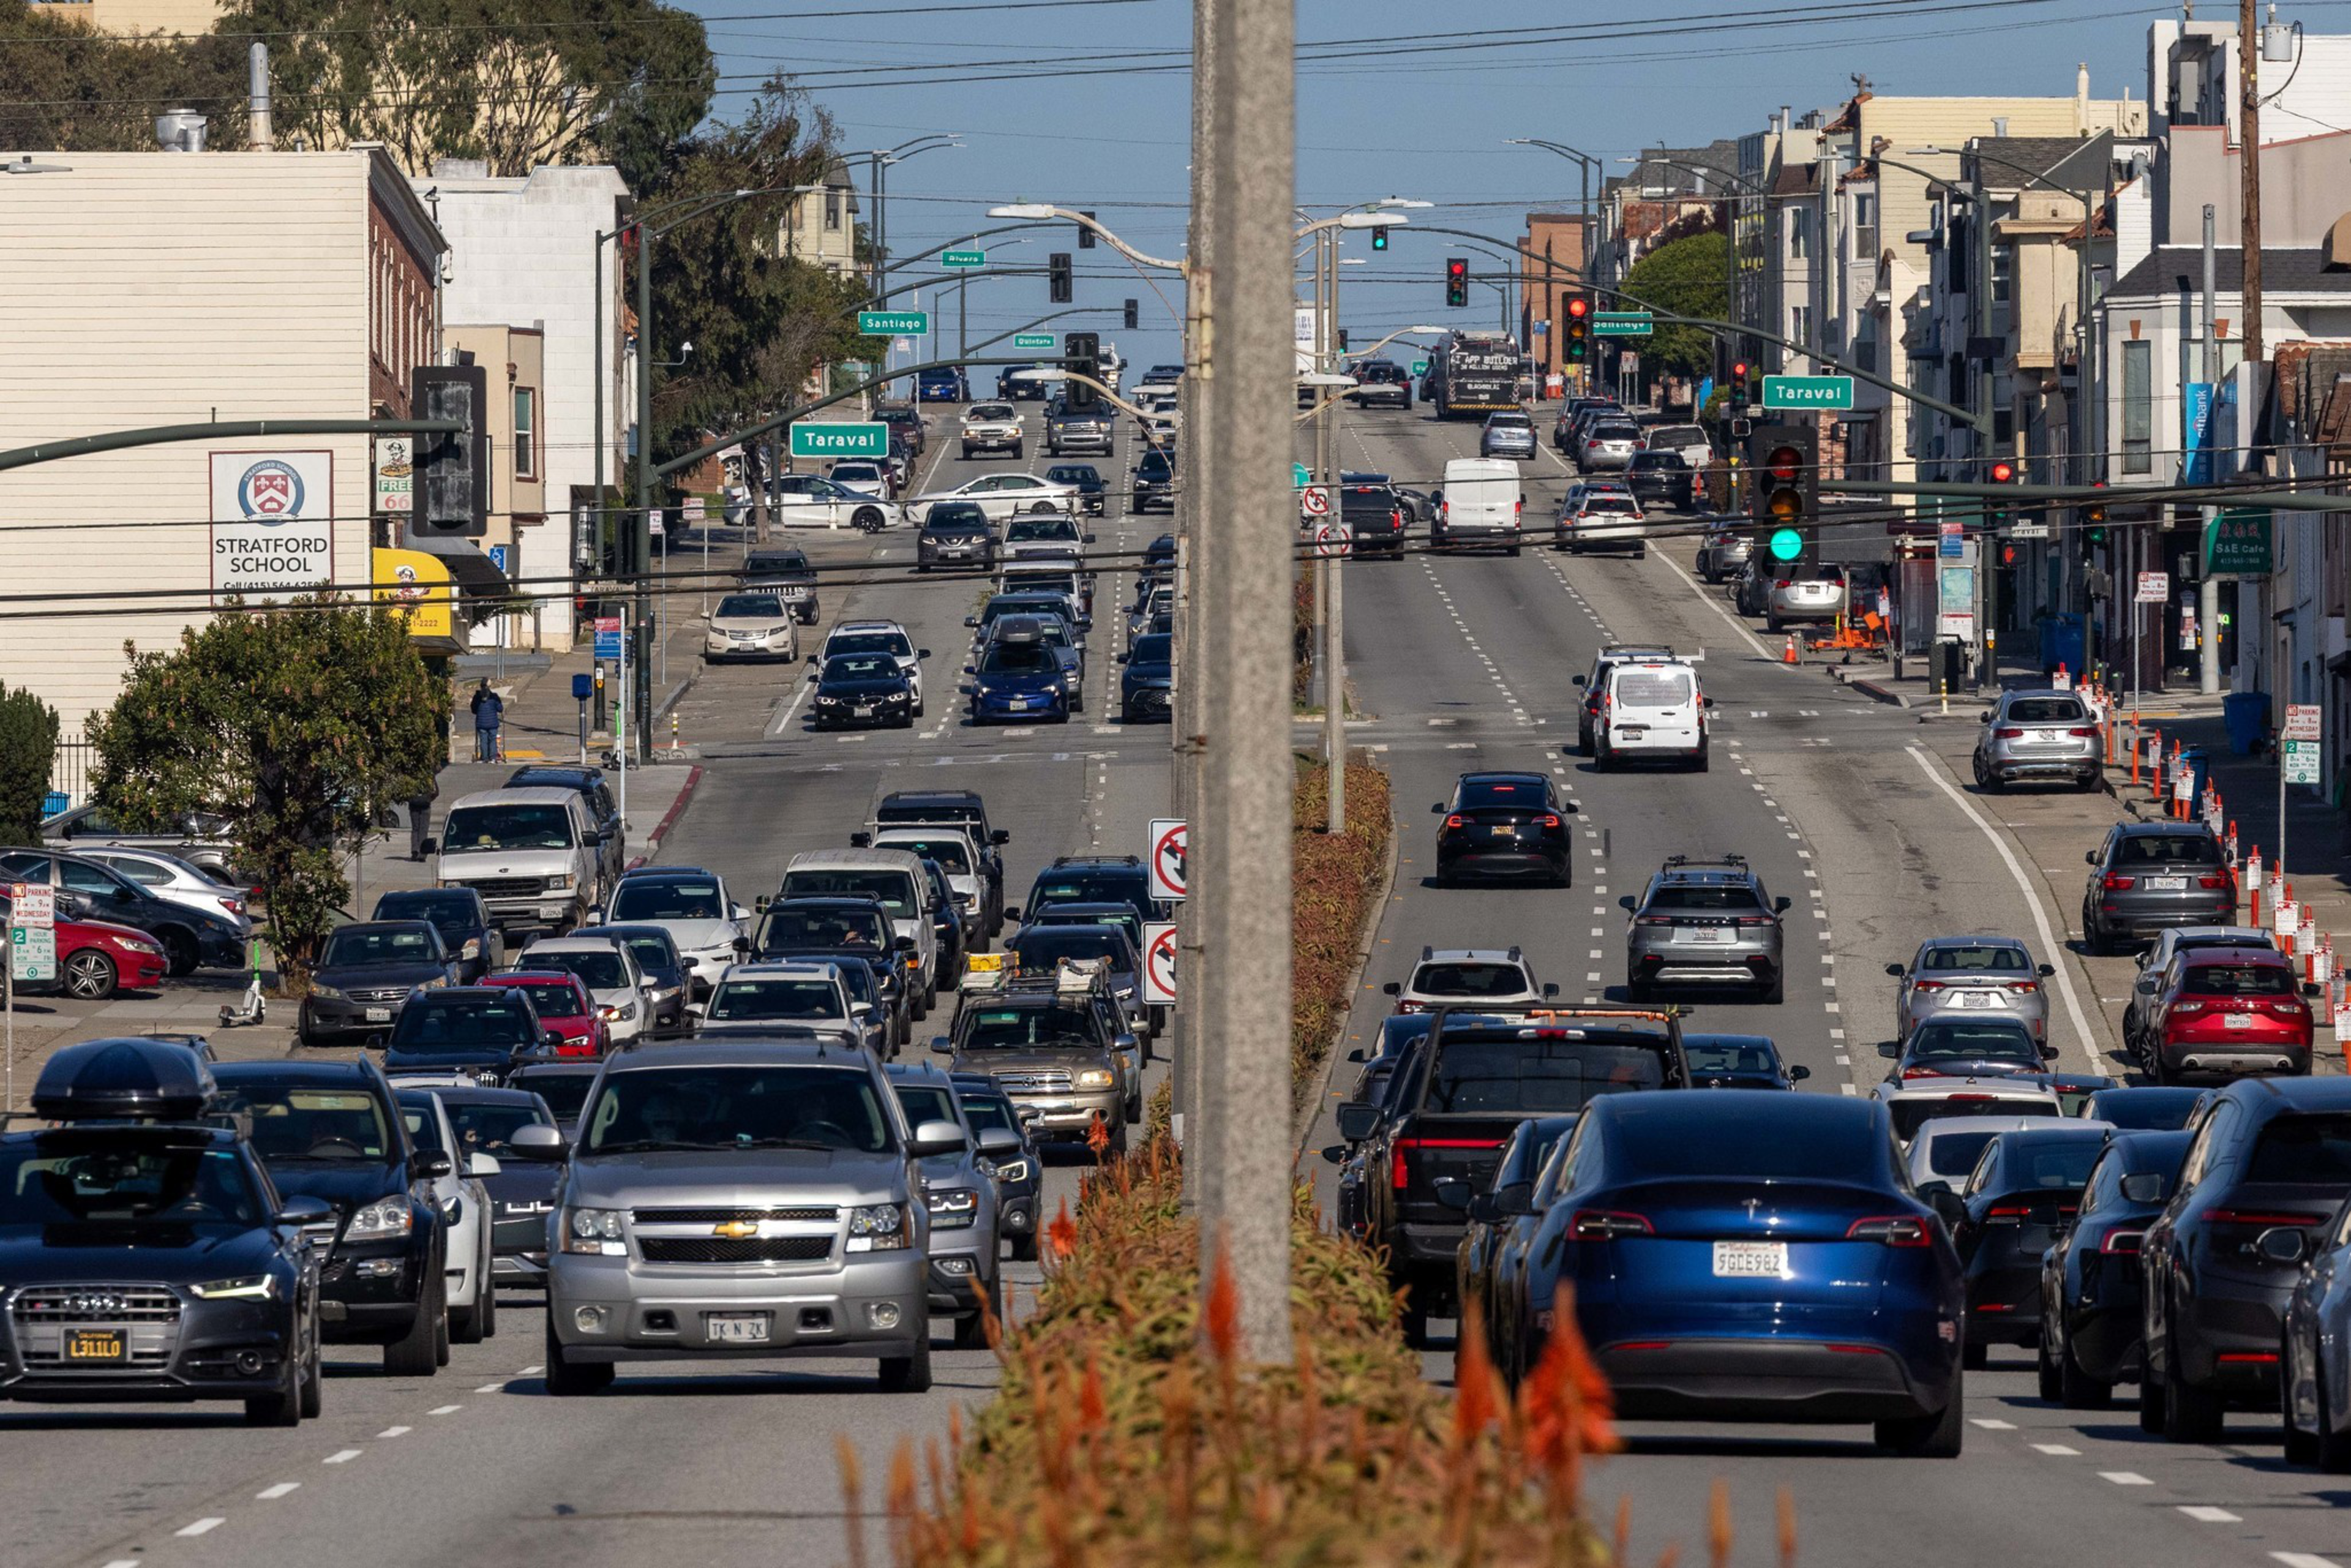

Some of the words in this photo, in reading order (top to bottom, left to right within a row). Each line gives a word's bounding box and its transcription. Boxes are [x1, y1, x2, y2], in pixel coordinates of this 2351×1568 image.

[867, 318, 920, 330] Santiago
[1483, 356, 1518, 365] BUILDER
[1776, 385, 1840, 399] Taraval
[2195, 390, 2207, 438] citibank
[805, 433, 874, 446] Taraval
[244, 462, 276, 482] STRATFORD
[277, 463, 298, 482] SCHOOL
[216, 538, 328, 553] STRATFORD
[2216, 543, 2238, 553] S&E
[2242, 544, 2265, 553] Cafe
[230, 557, 312, 573] SCHOOL
[2289, 743, 2295, 752] 2
[14, 886, 24, 896] NO
[28, 889, 52, 898] PARKING
[15, 931, 24, 942] 2
